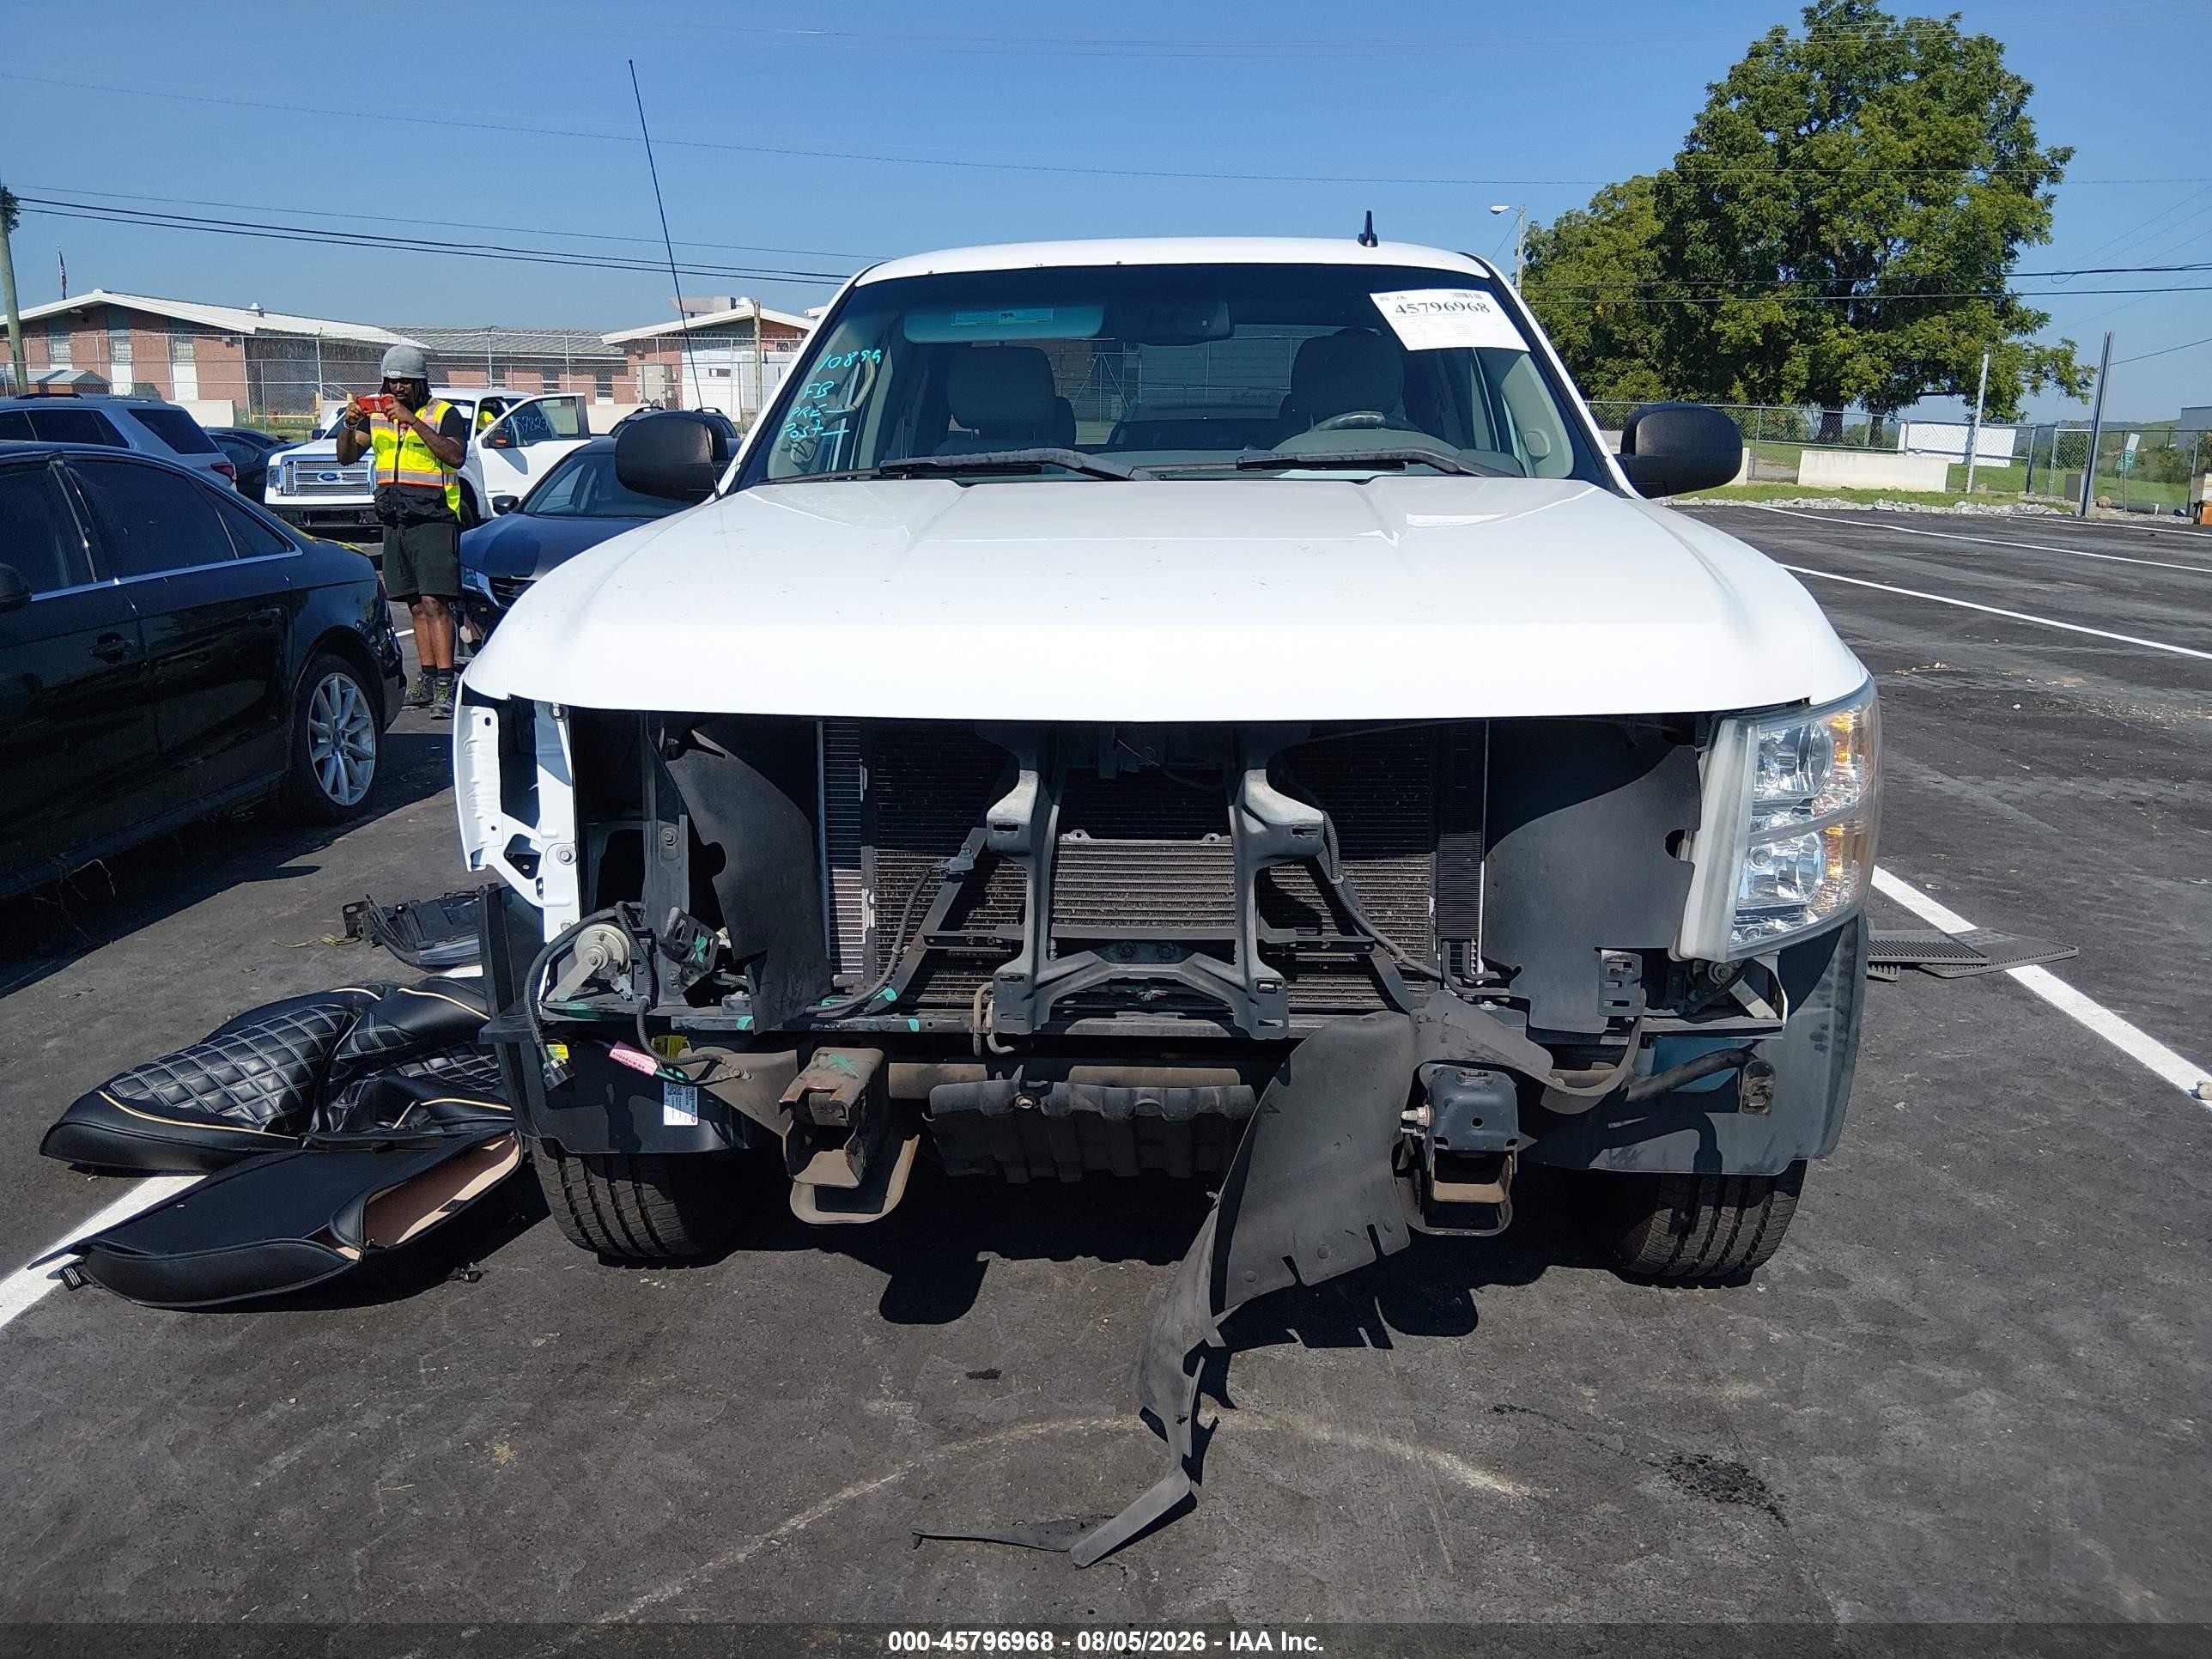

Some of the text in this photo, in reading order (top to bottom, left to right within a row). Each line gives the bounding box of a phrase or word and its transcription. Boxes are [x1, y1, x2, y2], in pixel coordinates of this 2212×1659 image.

[1395, 301, 1491, 314] 45796968
[802, 380, 835, 400] FB
[787, 404, 827, 422] PRE
[777, 419, 824, 441] POST
